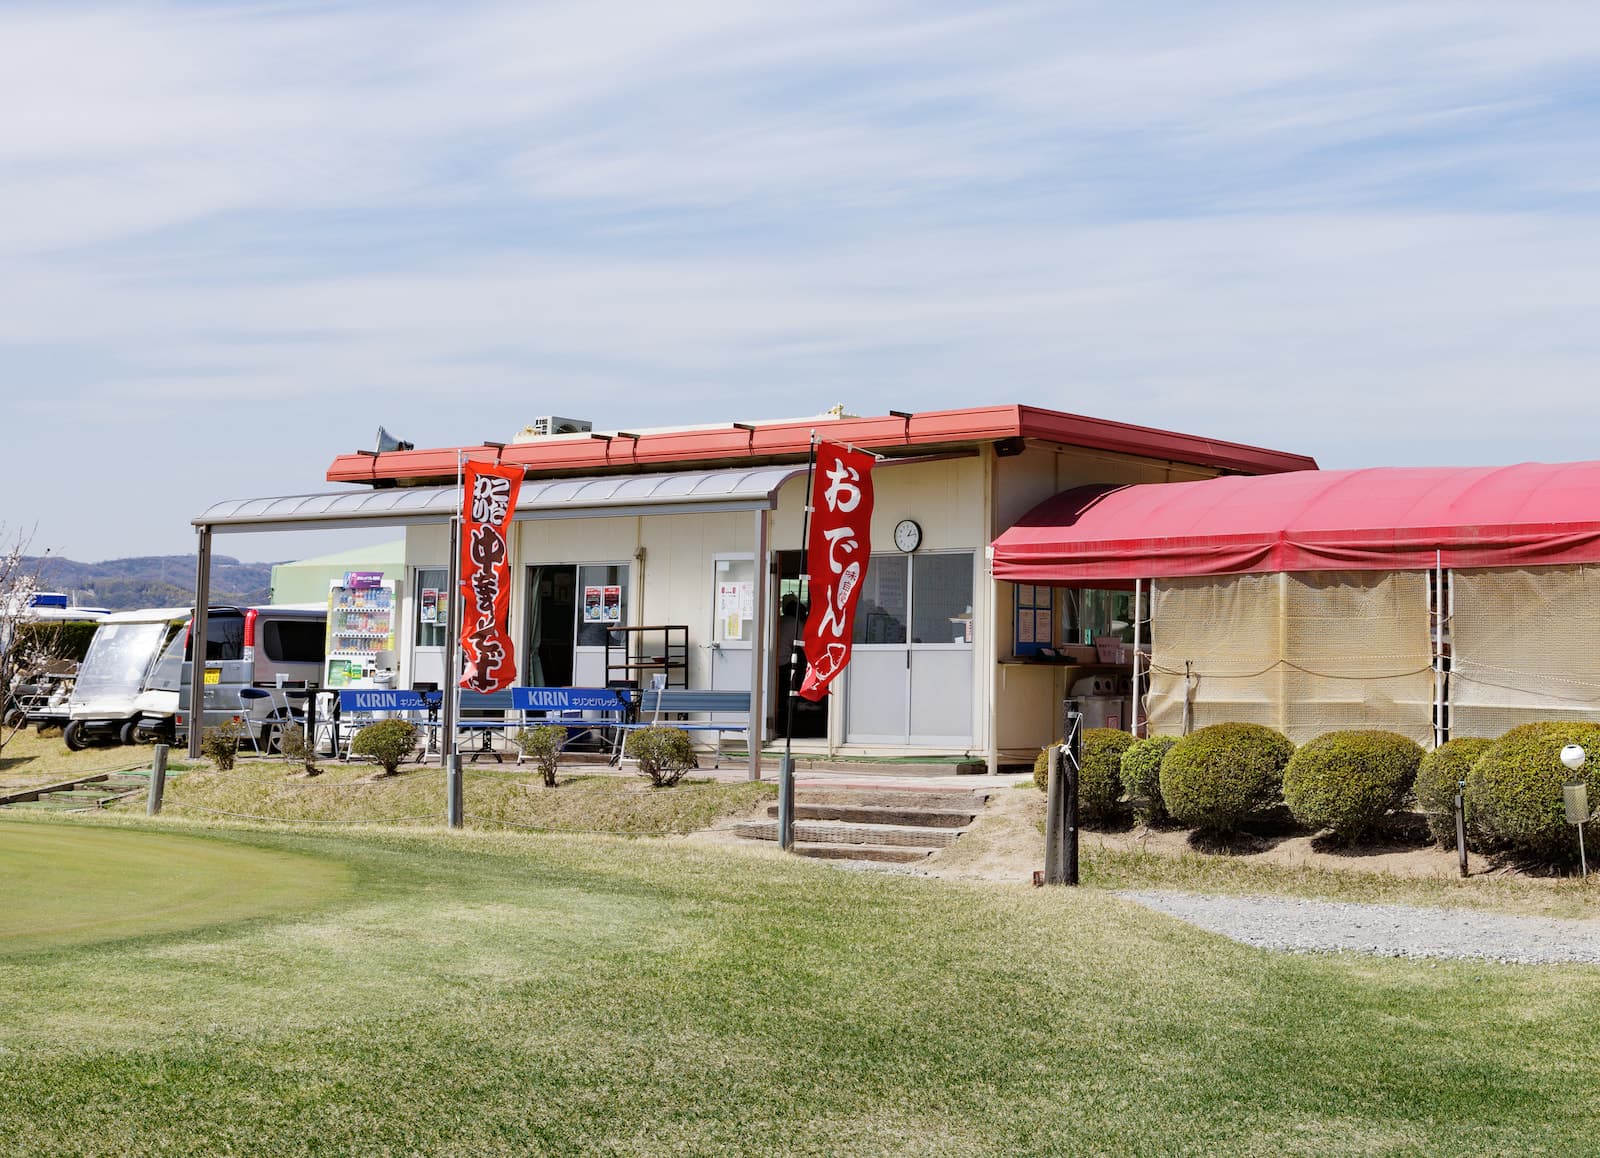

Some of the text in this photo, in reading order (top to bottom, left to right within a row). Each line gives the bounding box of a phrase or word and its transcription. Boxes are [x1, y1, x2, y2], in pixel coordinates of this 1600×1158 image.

[818, 458, 861, 638] おでん
[355, 693, 397, 708] KIRIN
[528, 691, 569, 706] KIRIN
